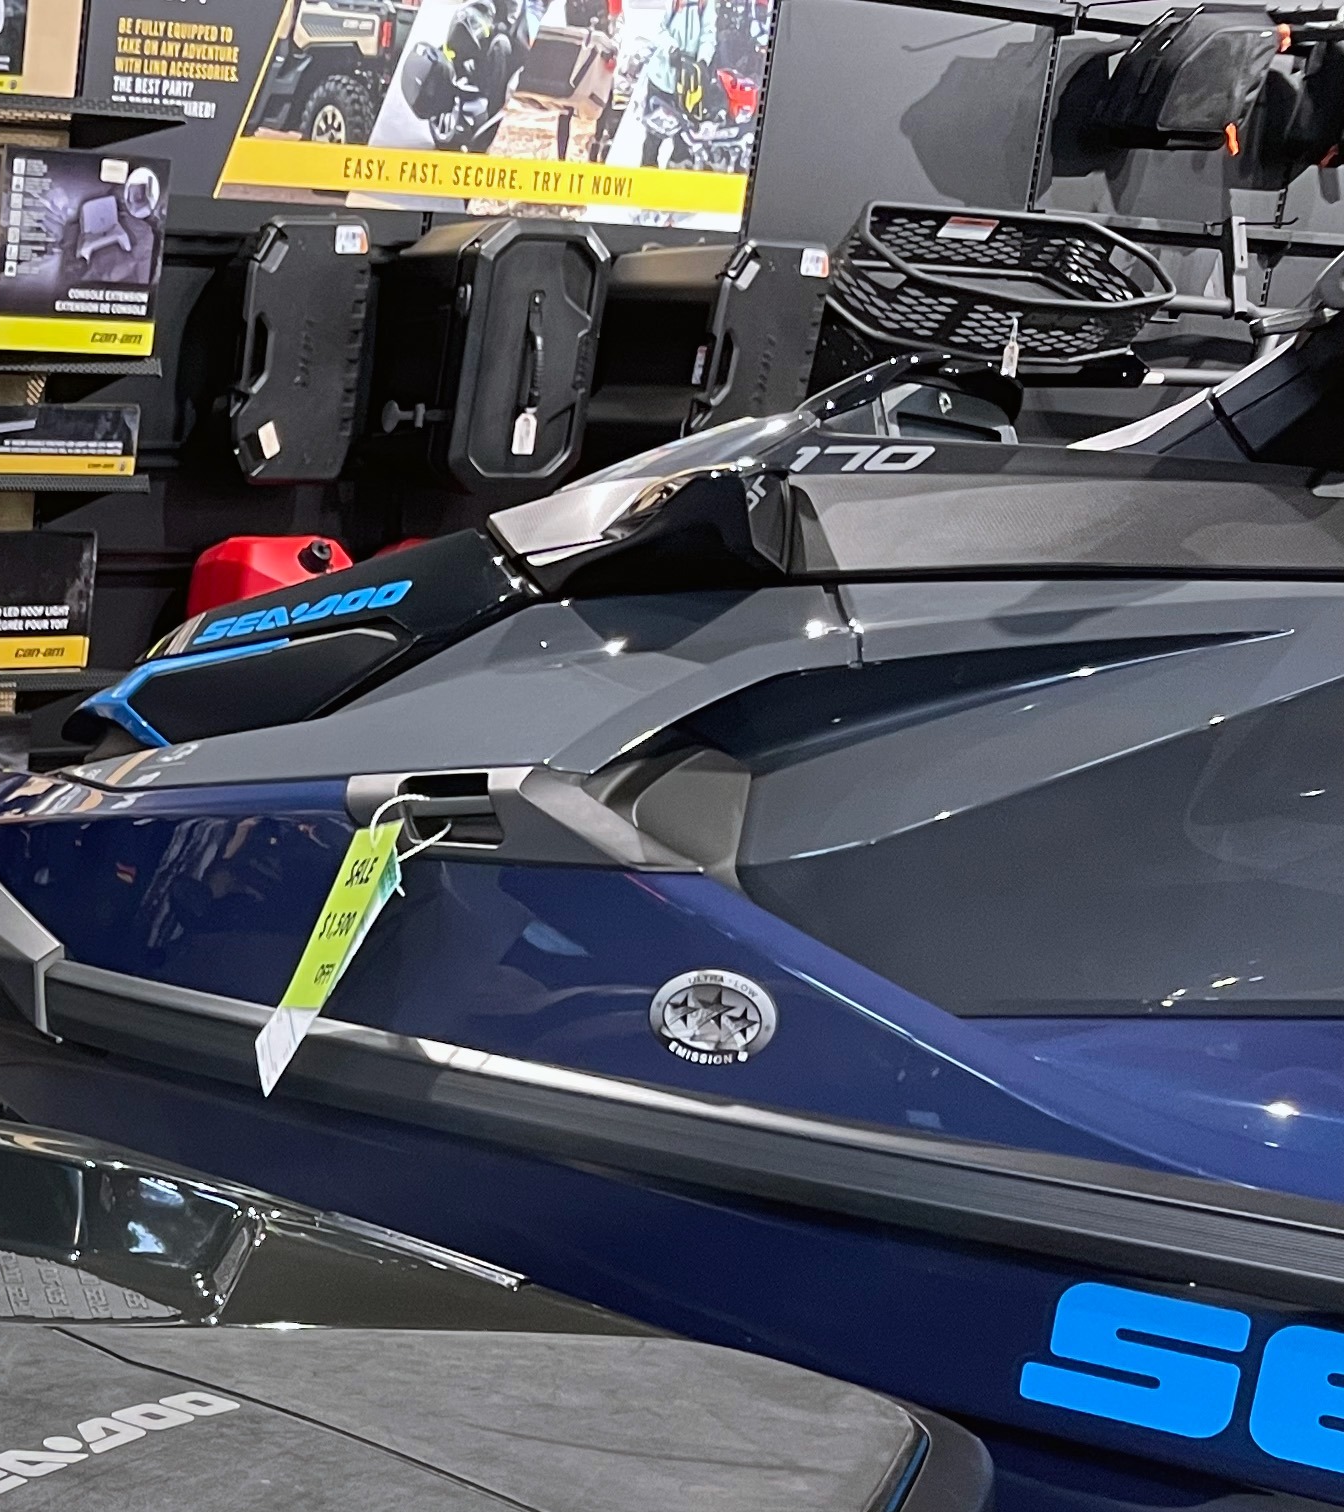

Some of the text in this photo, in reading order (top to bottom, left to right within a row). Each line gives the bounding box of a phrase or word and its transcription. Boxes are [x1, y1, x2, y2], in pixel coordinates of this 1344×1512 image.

[118, 17, 233, 43] BE FULLY EQUIPPED TO
[117, 36, 239, 63] TAKE ON ANY ADVENTURE
[115, 56, 142, 74] WITH
[169, 61, 239, 82] ACCESSORIES.
[113, 75, 194, 98] THE BEST PART?
[343, 157, 633, 198] EASY. FAST. SECURE. TRY IT NOW!
[789, 445, 936, 473] 170
[45, 605, 69, 616] LIGHT
[345, 856, 378, 887] SALE
[318, 911, 357, 940] $1,500
[668, 1041, 733, 1065] EMISSION
